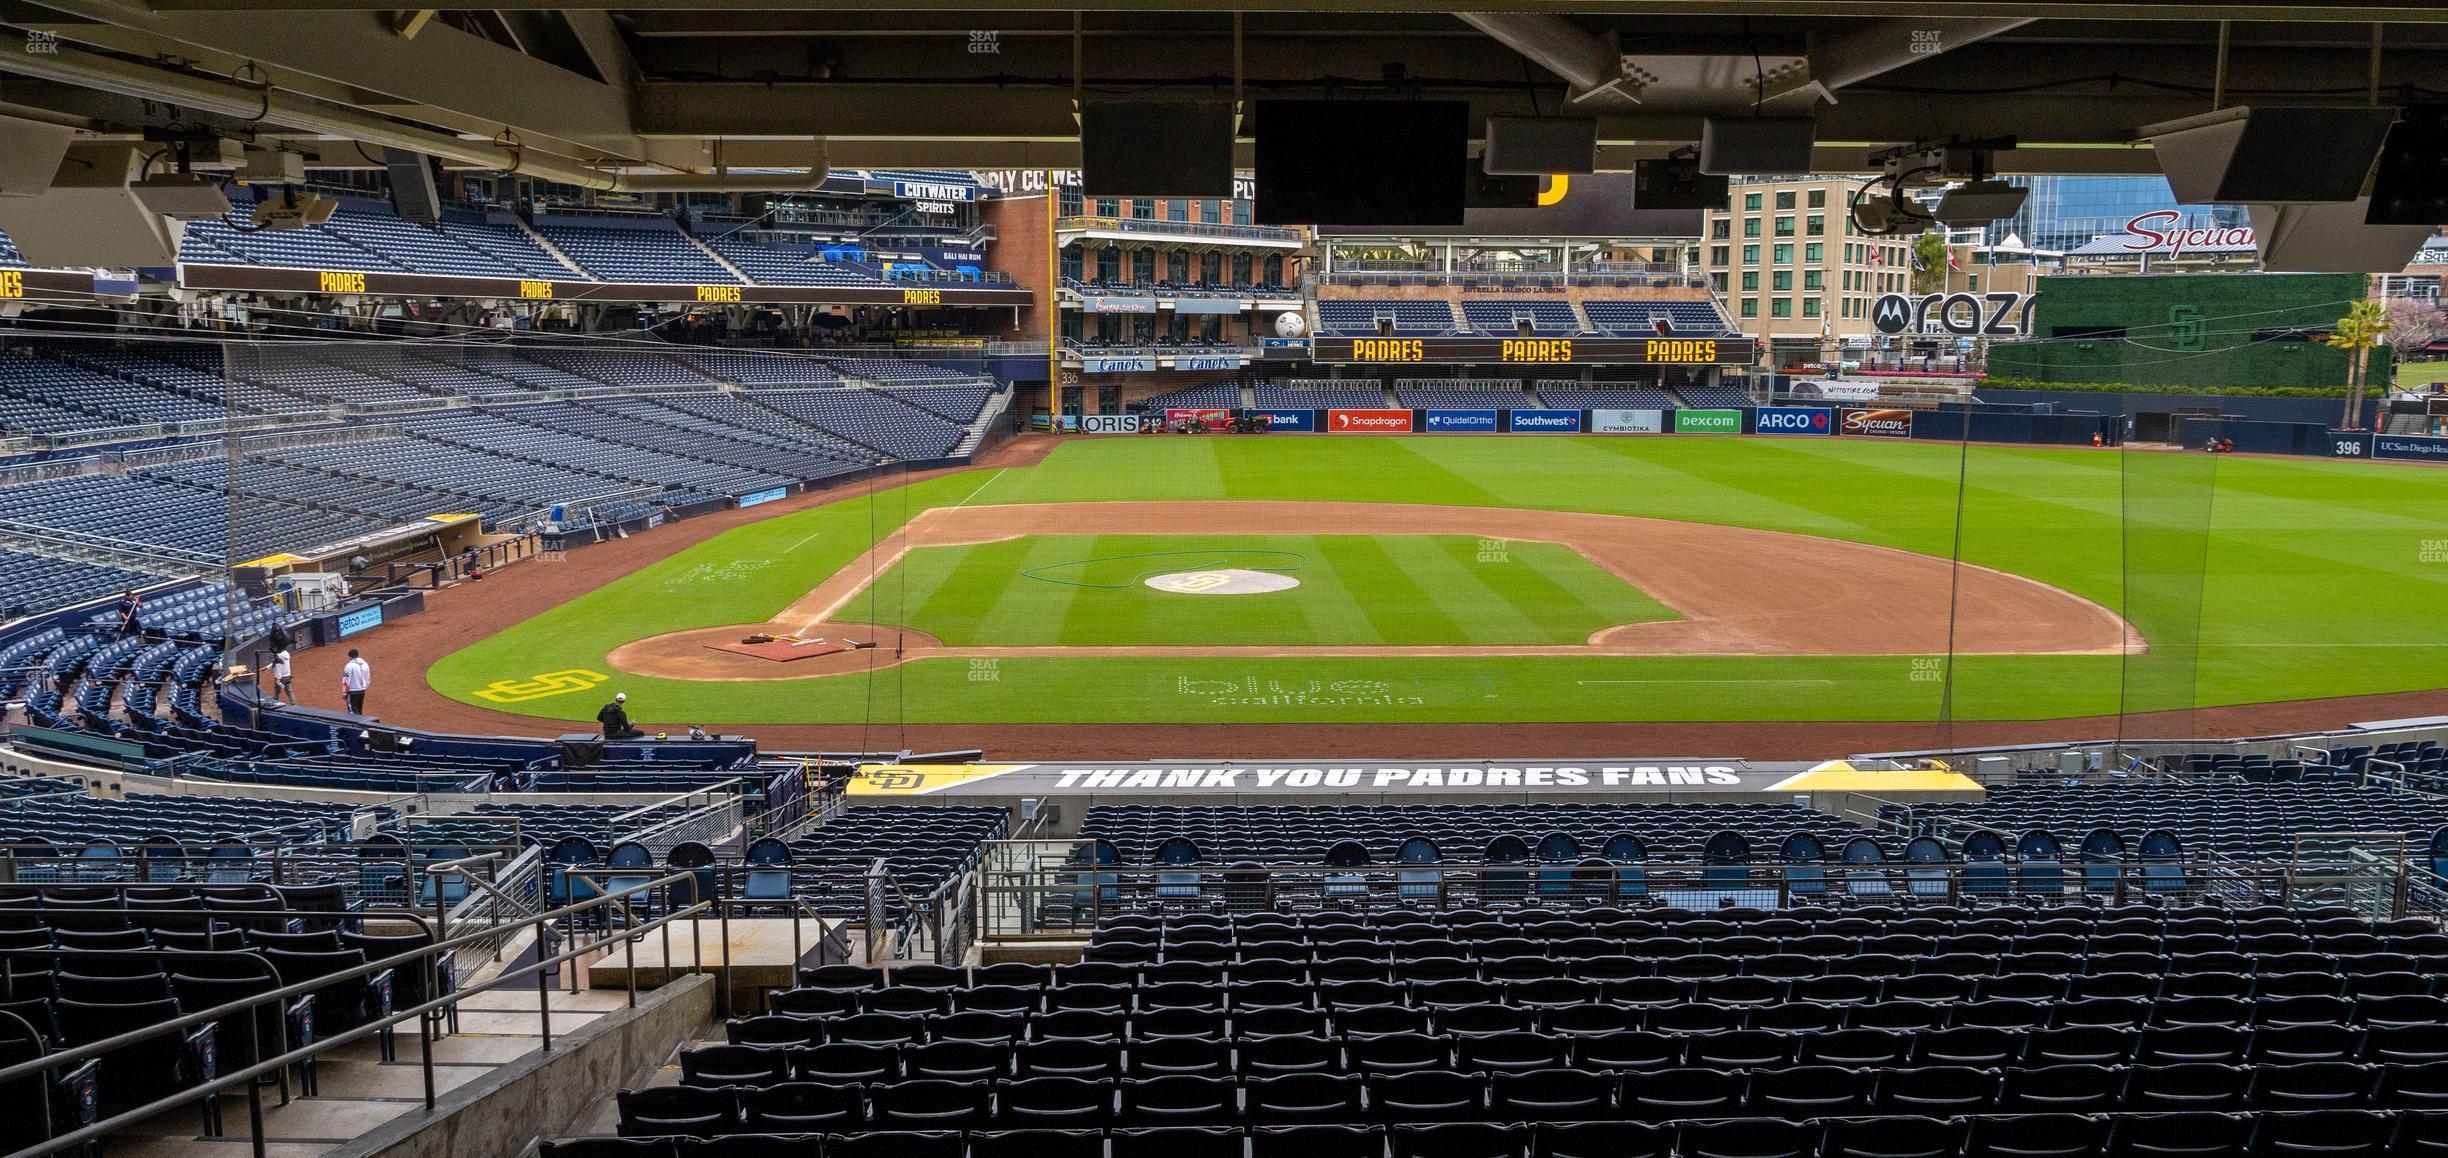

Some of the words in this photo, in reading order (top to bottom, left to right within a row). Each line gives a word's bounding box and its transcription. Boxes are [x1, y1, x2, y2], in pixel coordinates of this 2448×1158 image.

[1022, 170, 1048, 191] CO.
[904, 183, 967, 200] CUTWATER
[916, 201, 955, 214] SPIRITS
[943, 252, 957, 260] BALI
[958, 252, 968, 261] HAI
[969, 253, 982, 261] RUM
[0, 271, 23, 298] ES
[320, 271, 365, 293] PADRES
[520, 280, 553, 298] PADRES
[697, 285, 741, 301] PADRES
[904, 289, 940, 304] PADRES
[1353, 339, 1424, 361] PADRES
[1502, 339, 1572, 362] PADRES
[1646, 340, 1717, 362] PADRES
[1099, 357, 1144, 371] Canel's
[1189, 356, 1230, 370] Canel's
[1062, 372, 1079, 384] 336
[1085, 416, 1137, 432] ORIS
[1273, 414, 1299, 424] bank
[1352, 416, 1407, 427] Snapdragon
[1442, 416, 1494, 425] QuidelOrtho
[1515, 415, 1568, 426] Southwest
[1758, 414, 1809, 428] ARCO
[1845, 411, 1905, 434] Sycuan
[2336, 441, 2361, 455] 396
[2381, 442, 2395, 450] UC
[2394, 442, 2409, 451] San
[2410, 443, 2432, 454] Diego
[340, 616, 360, 631] petco
[1178, 675, 1389, 694] blue
[1212, 695, 1424, 704] california
[869, 769, 925, 790] SD
[1054, 768, 1246, 788] THANK
[1254, 768, 1364, 787] YOU
[1372, 767, 1590, 788] PADRES
[1600, 766, 1742, 786] FANS
